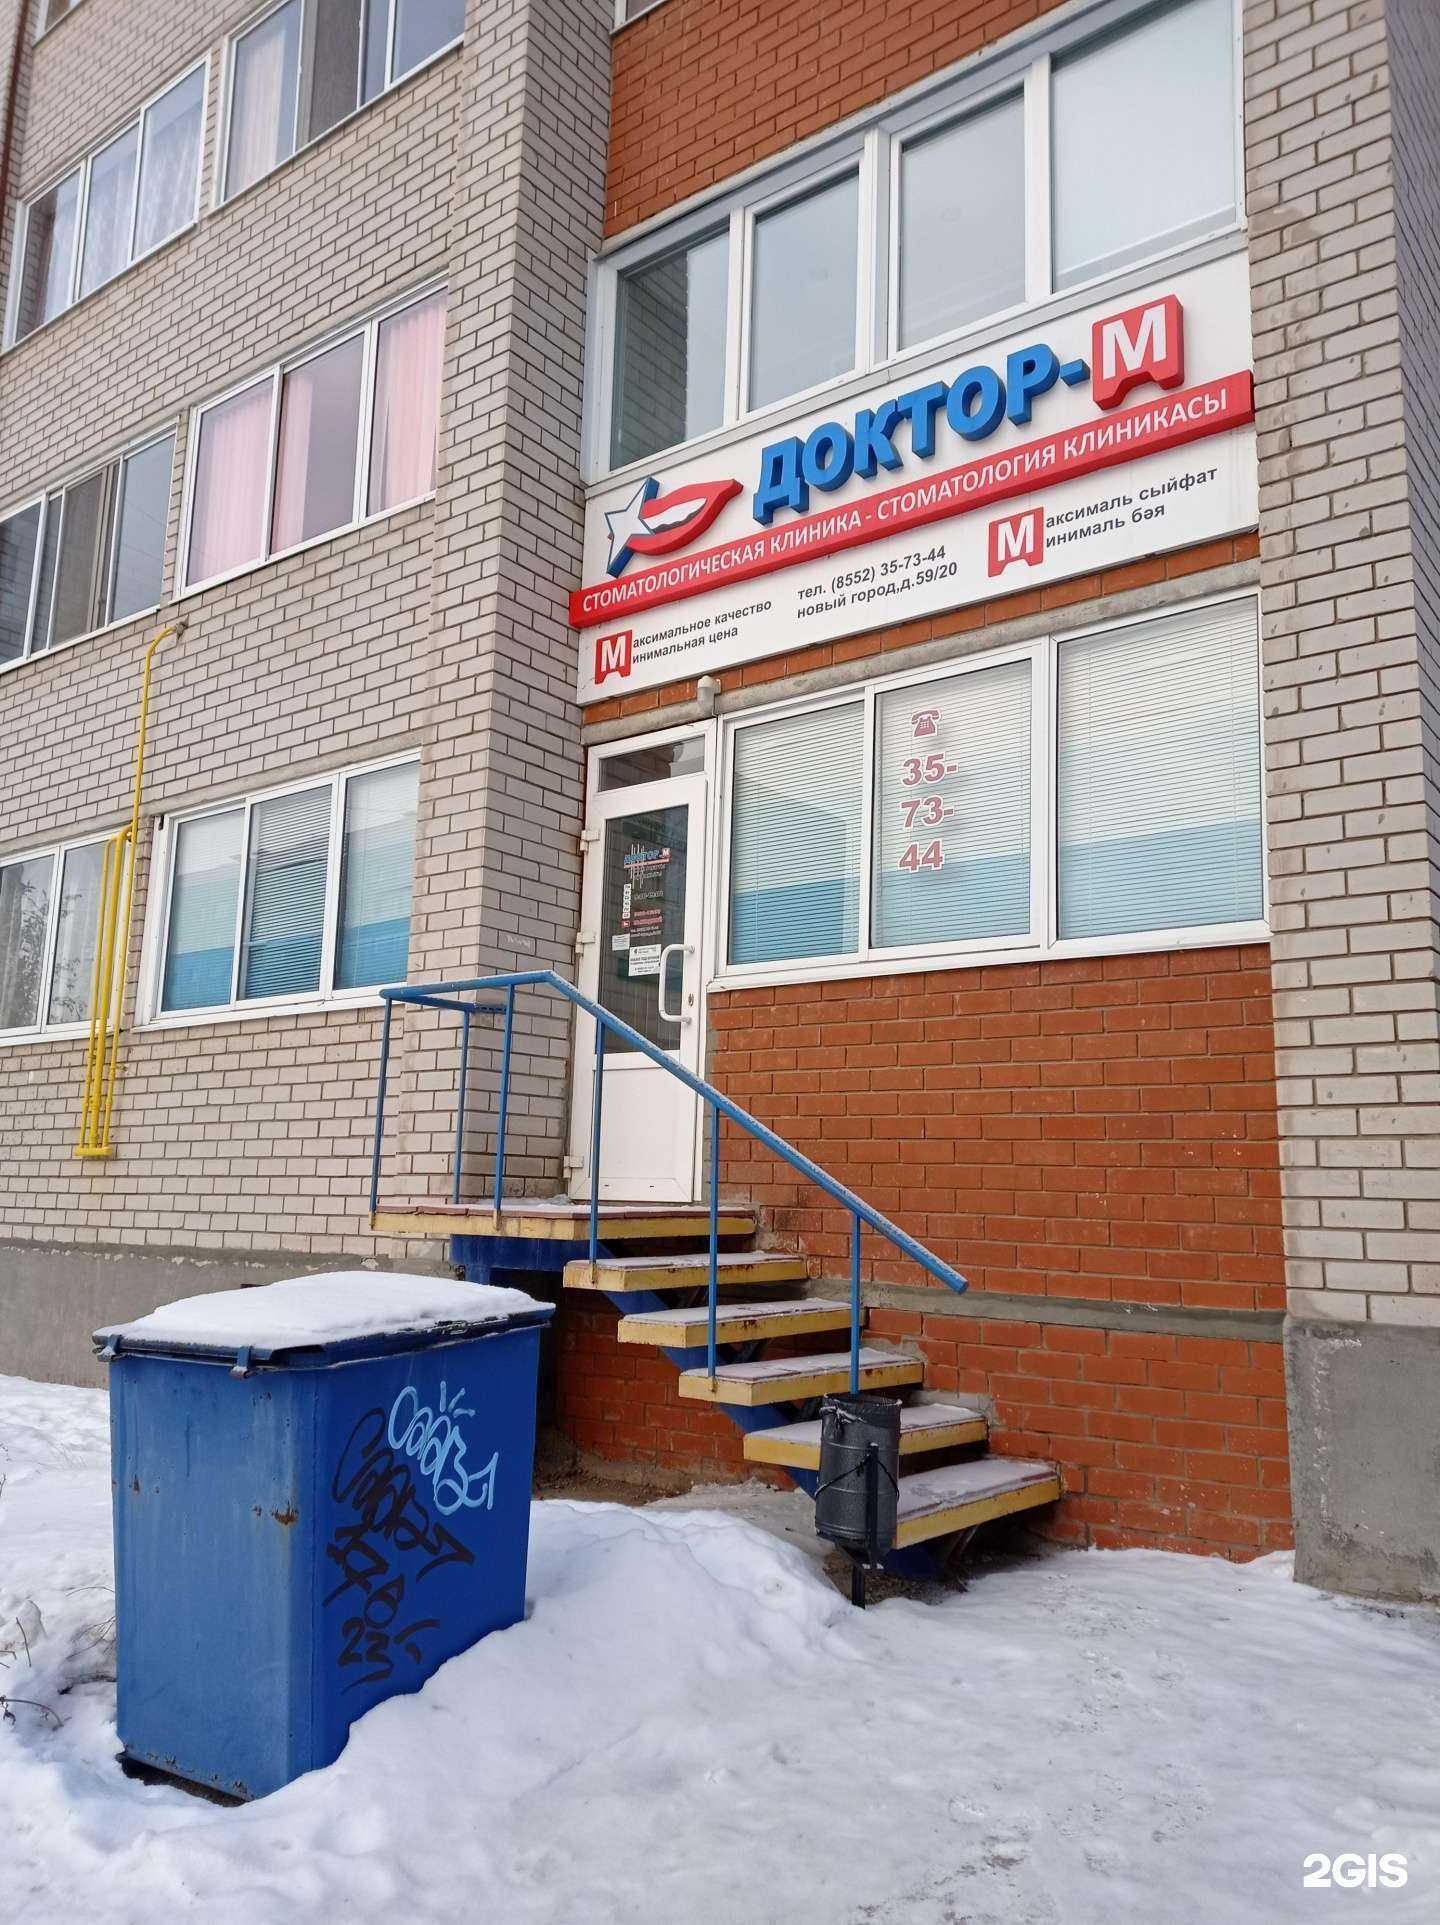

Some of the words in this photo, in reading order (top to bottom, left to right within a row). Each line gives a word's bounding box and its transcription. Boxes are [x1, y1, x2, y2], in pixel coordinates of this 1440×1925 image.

[753, 298, 1180, 525] ДОКТОР-М
[583, 538, 765, 613] СТОМАТОЛОГИЧЕСКАЯ
[770, 510, 863, 553] КЛИНИКА
[877, 447, 1056, 520] СТОМАТОЛОГИЯ
[1063, 388, 1228, 461] КЛИНИКАСЫ
[1138, 468, 1218, 502] сыйфат
[1130, 504, 1166, 525] бәя
[797, 584, 827, 600] тел.
[831, 566, 876, 594] (8552)
[880, 545, 946, 577] 35-73-44
[714, 600, 772, 625] качество
[797, 594, 847, 619] новый
[708, 626, 739, 644] цена
[901, 753, 958, 786] 35-
[900, 794, 954, 828] 73-
[898, 840, 944, 872] 44
